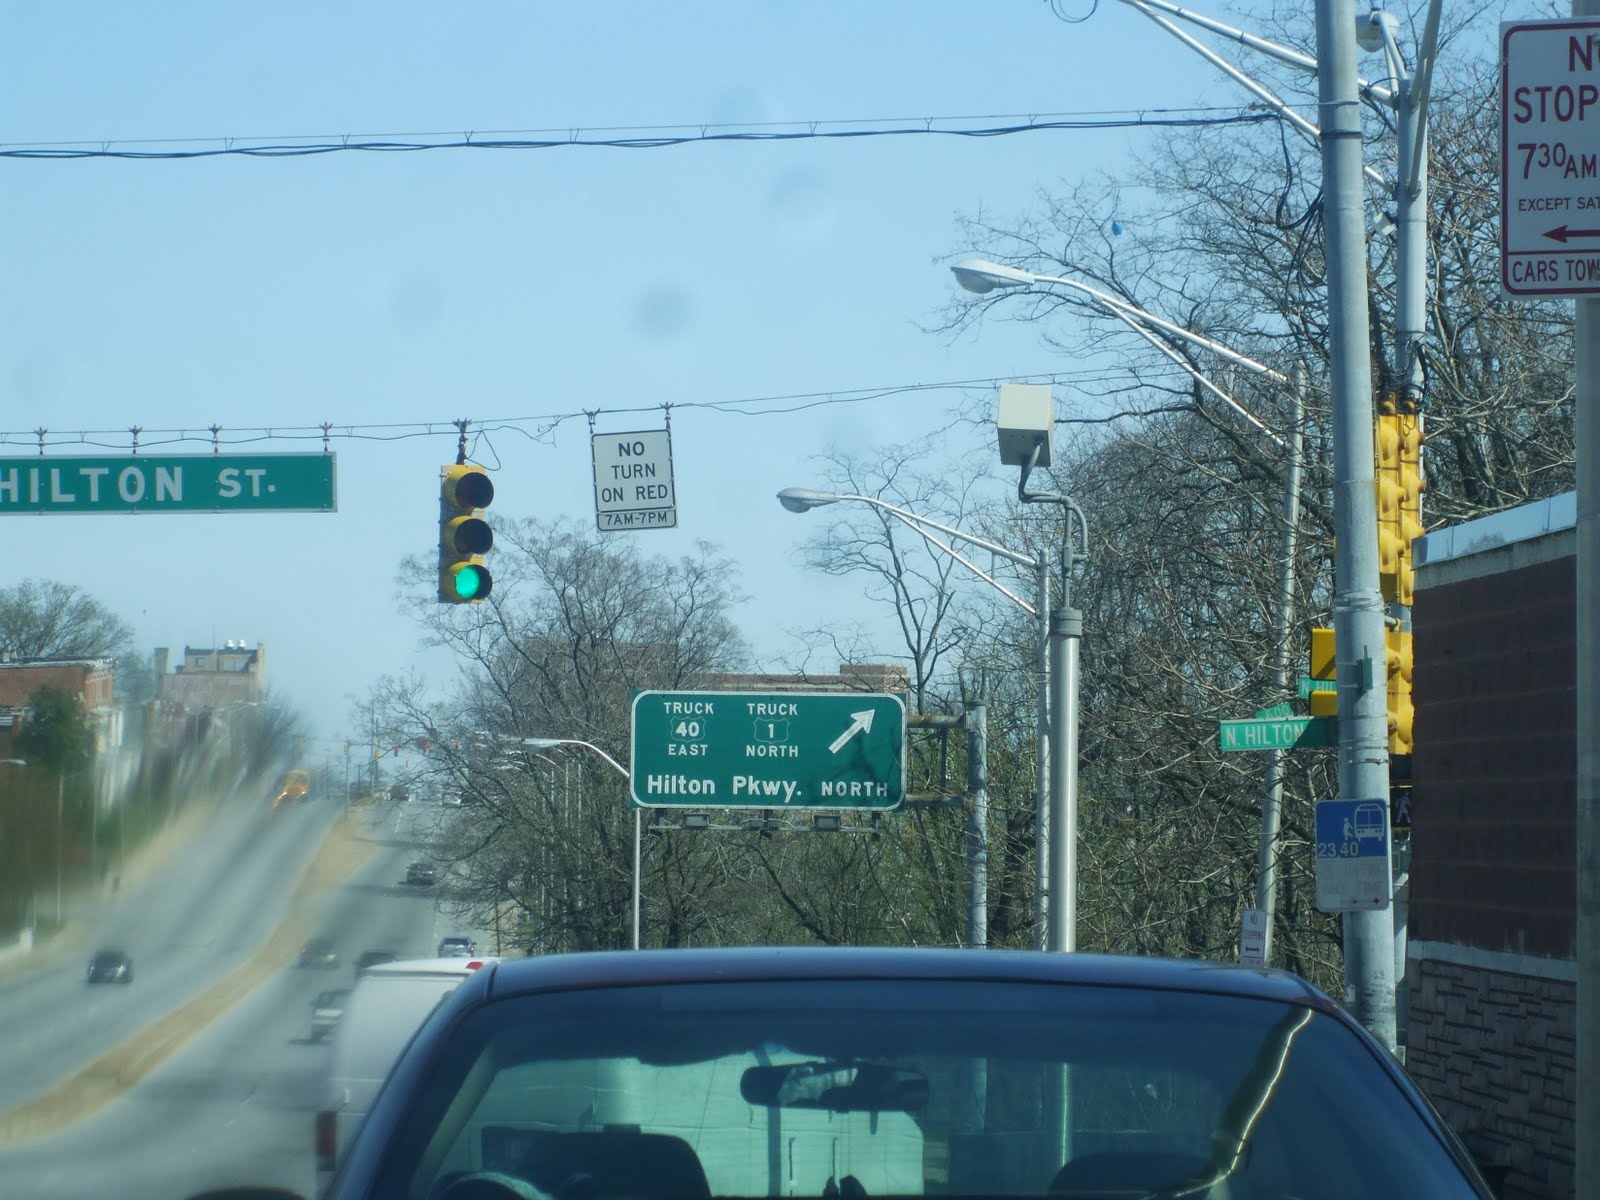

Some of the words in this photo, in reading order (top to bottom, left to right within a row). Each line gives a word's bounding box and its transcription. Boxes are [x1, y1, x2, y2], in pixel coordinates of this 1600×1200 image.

[1569, 35, 1600, 72] N
[1513, 85, 1599, 123] STOP
[1518, 197, 1571, 211] EXCEPT
[1512, 260, 1559, 283] CARS
[618, 441, 645, 457] NO
[611, 463, 656, 480] TURN
[0, 466, 182, 503] HILTON
[218, 467, 276, 498] ST.
[601, 487, 624, 503] ON
[636, 484, 668, 500] RED
[604, 511, 667, 526] 7AM-7PM
[664, 702, 714, 715] TRUCK
[747, 703, 798, 716] TRUCK
[675, 721, 700, 737] 40
[767, 723, 774, 739] 1
[1226, 727, 1241, 746] N.
[1245, 723, 1304, 745] HILTON
[668, 744, 709, 756] EAST
[746, 745, 799, 758] NORTH
[647, 775, 716, 795] Hilton
[733, 775, 802, 803] Pkwy.
[821, 781, 888, 797] NORTH
